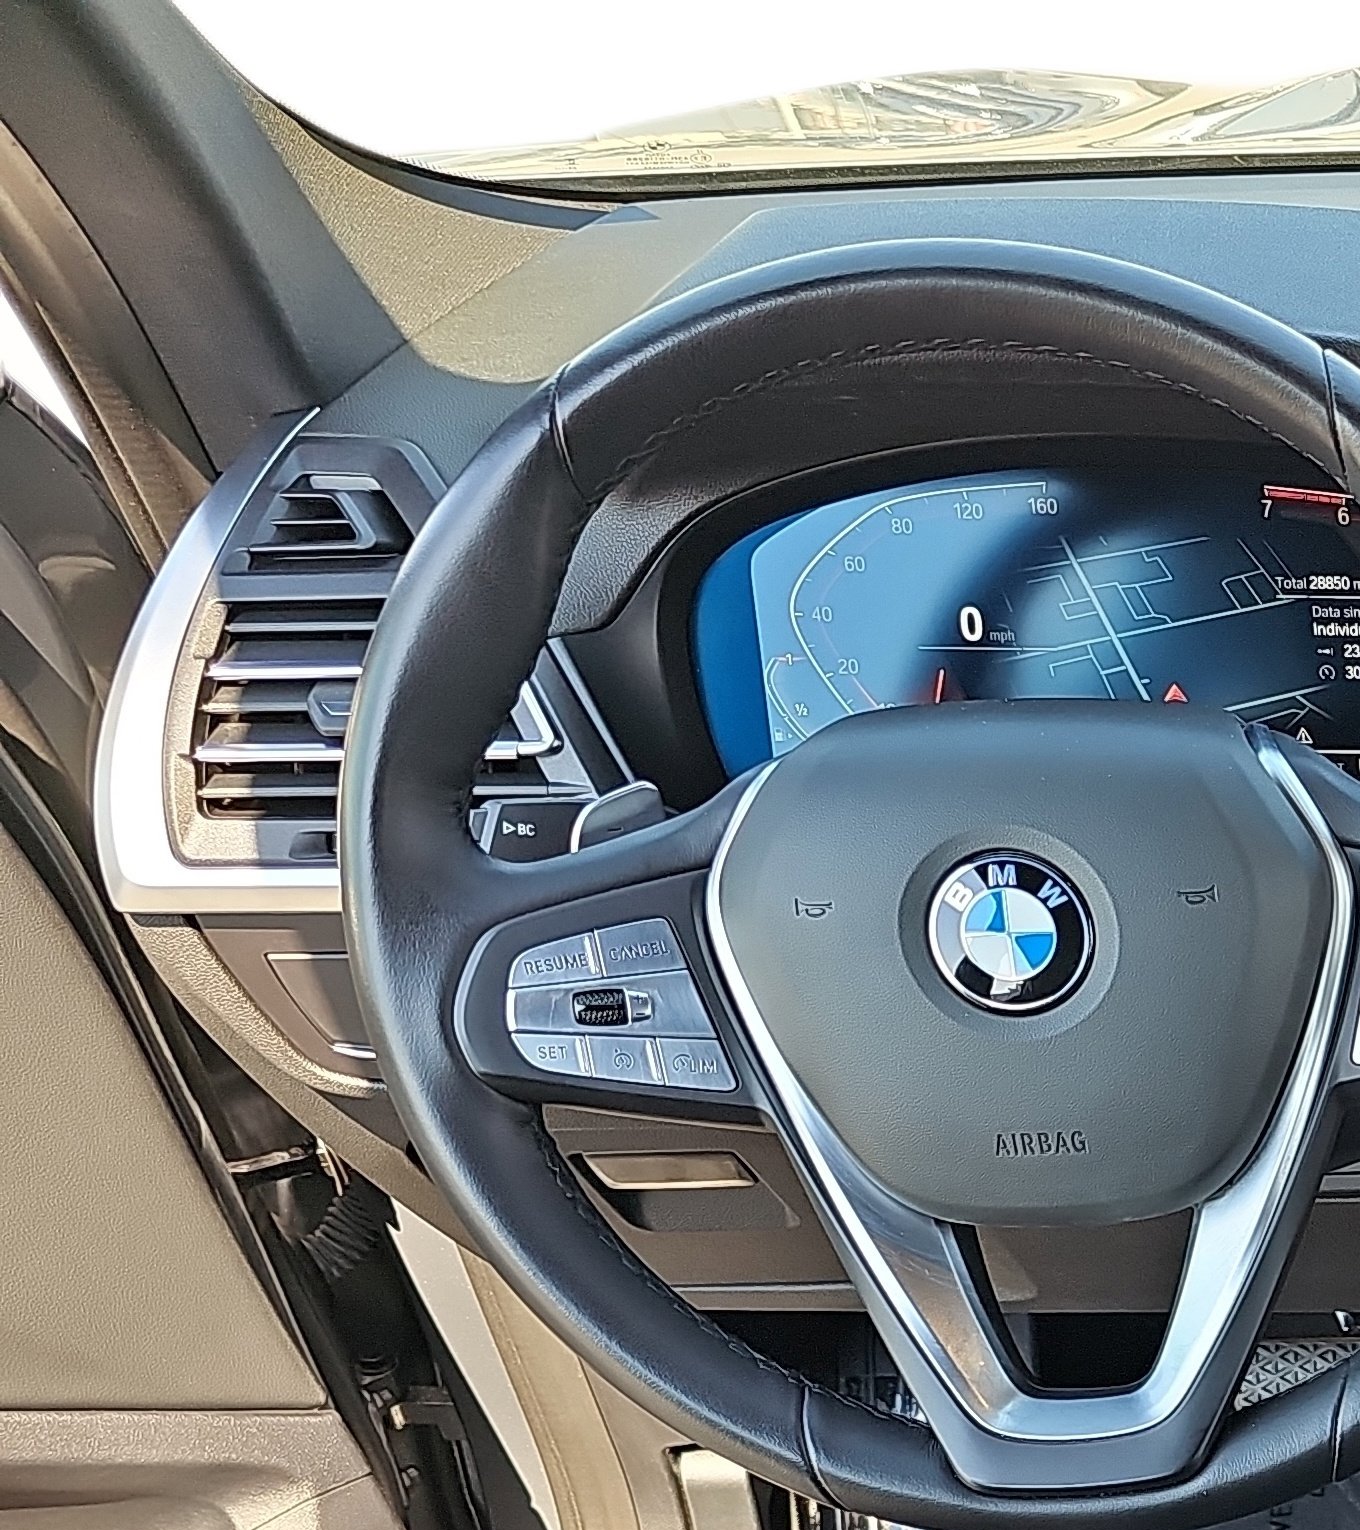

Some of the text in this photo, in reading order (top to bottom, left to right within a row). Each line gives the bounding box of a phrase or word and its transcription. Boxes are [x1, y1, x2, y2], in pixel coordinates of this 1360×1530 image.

[954, 503, 983, 519] 120
[1028, 498, 1058, 515] 160
[1261, 500, 1272, 518] 7
[1338, 507, 1350, 525] 6
[891, 519, 913, 534] 80
[844, 556, 865, 572] 60
[1276, 577, 1307, 589] Total
[1309, 577, 1350, 590] 28850
[812, 607, 833, 622] 40
[1312, 606, 1340, 618] Data
[960, 605, 1015, 644] 0 mph
[838, 659, 859, 674] 20
[517, 823, 536, 836] BC
[944, 864, 1069, 912] BMW
[609, 941, 669, 961] CANCEL
[524, 952, 588, 975] RESUME
[538, 1046, 567, 1059] SET
[689, 1058, 718, 1074] LIM
[995, 1130, 1089, 1157] AIRBAG
